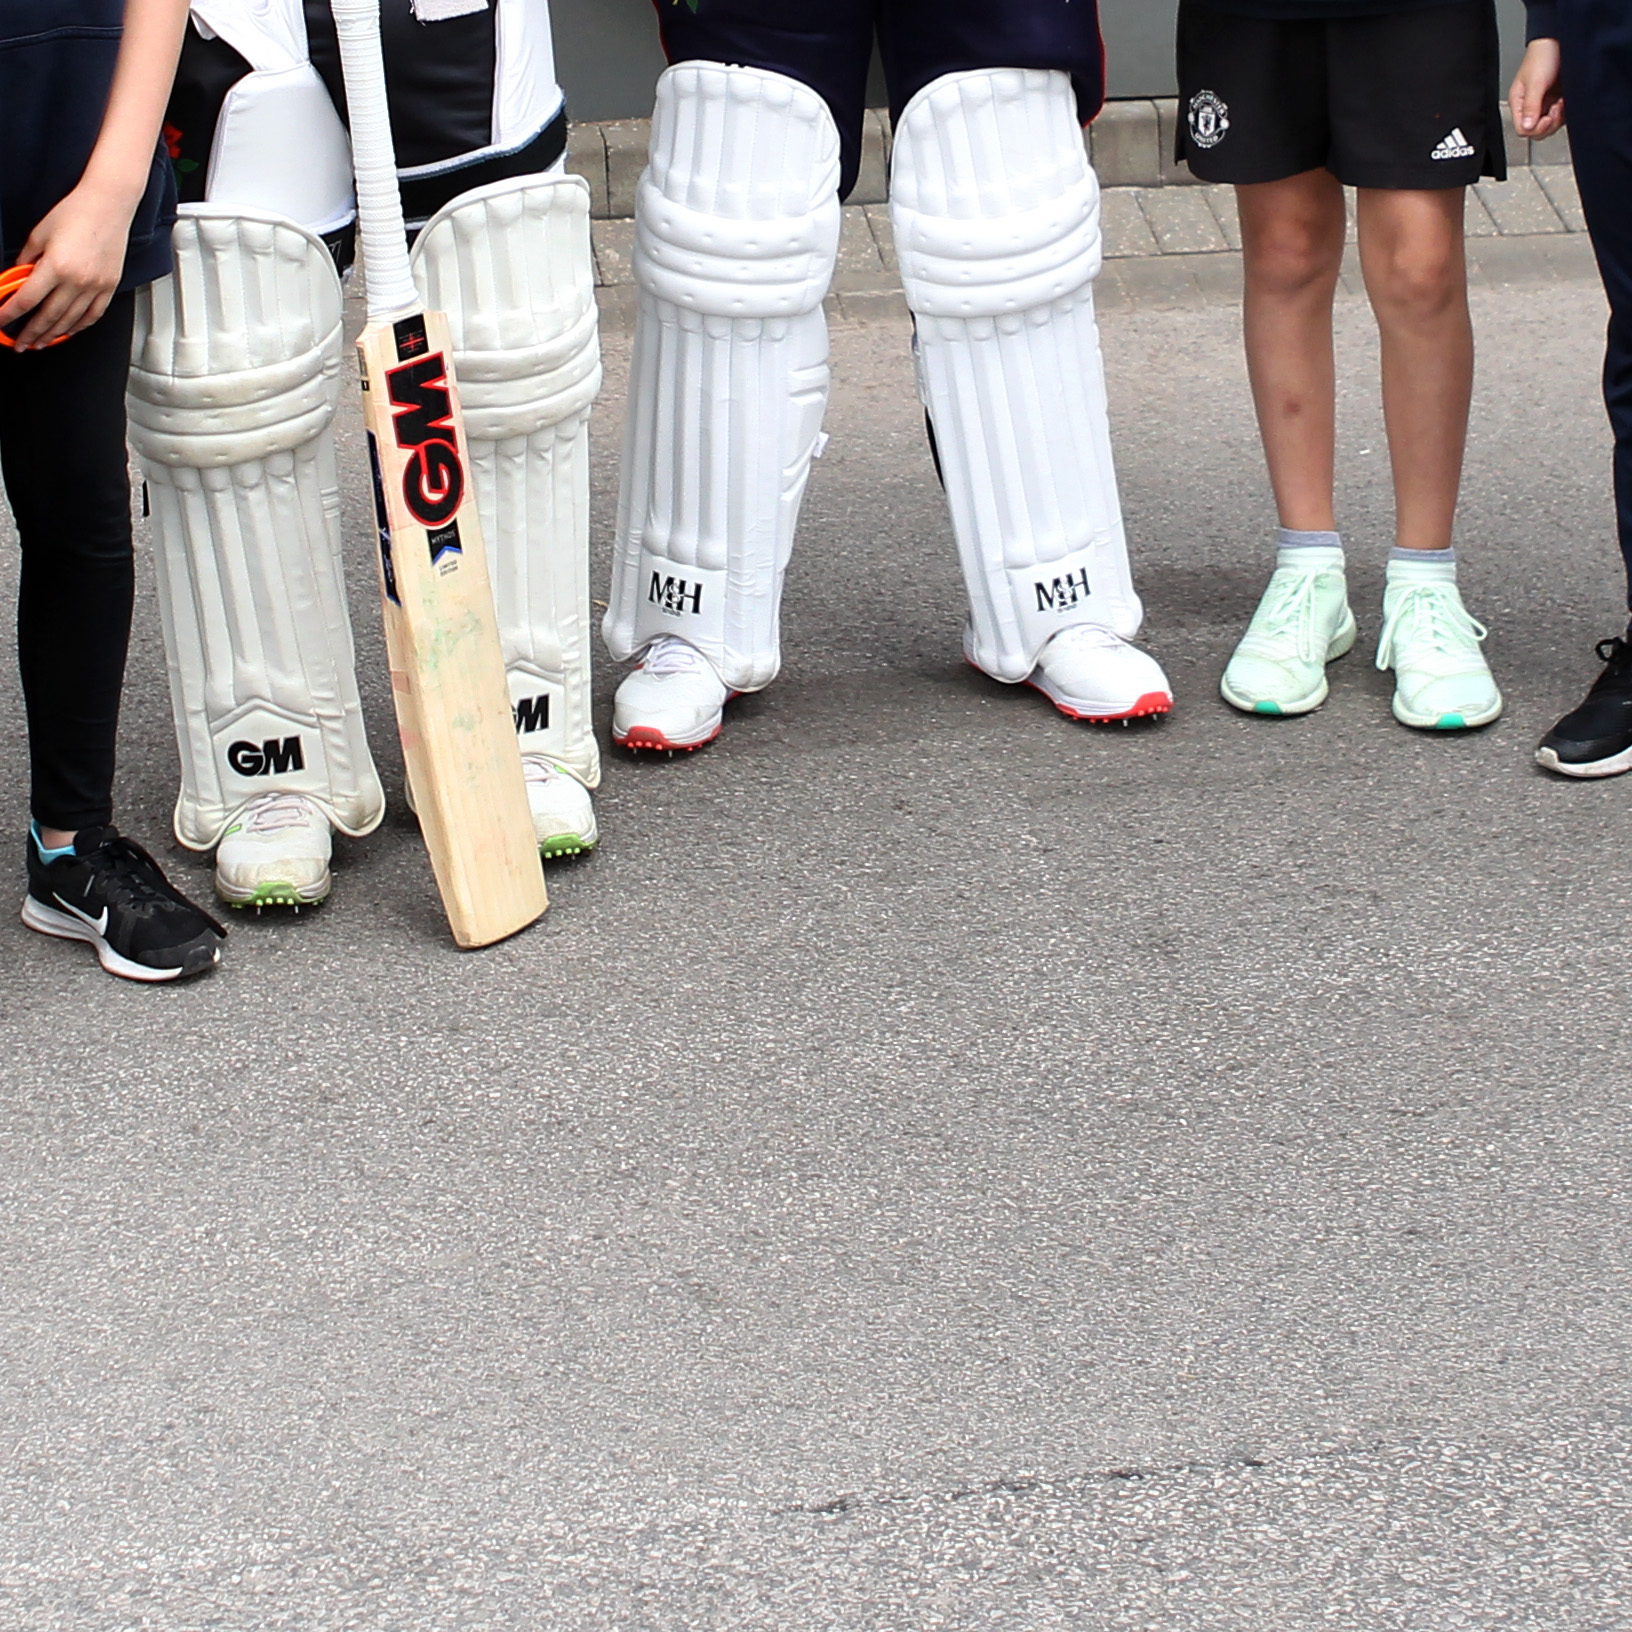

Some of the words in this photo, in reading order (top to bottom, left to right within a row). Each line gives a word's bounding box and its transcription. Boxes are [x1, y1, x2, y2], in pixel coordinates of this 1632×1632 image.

[1431, 145, 1475, 160] adidas
[385, 351, 464, 526] GM
[648, 569, 703, 615] M&H
[1034, 567, 1092, 612] M&H
[511, 693, 549, 735] M
[227, 734, 305, 778] GM
